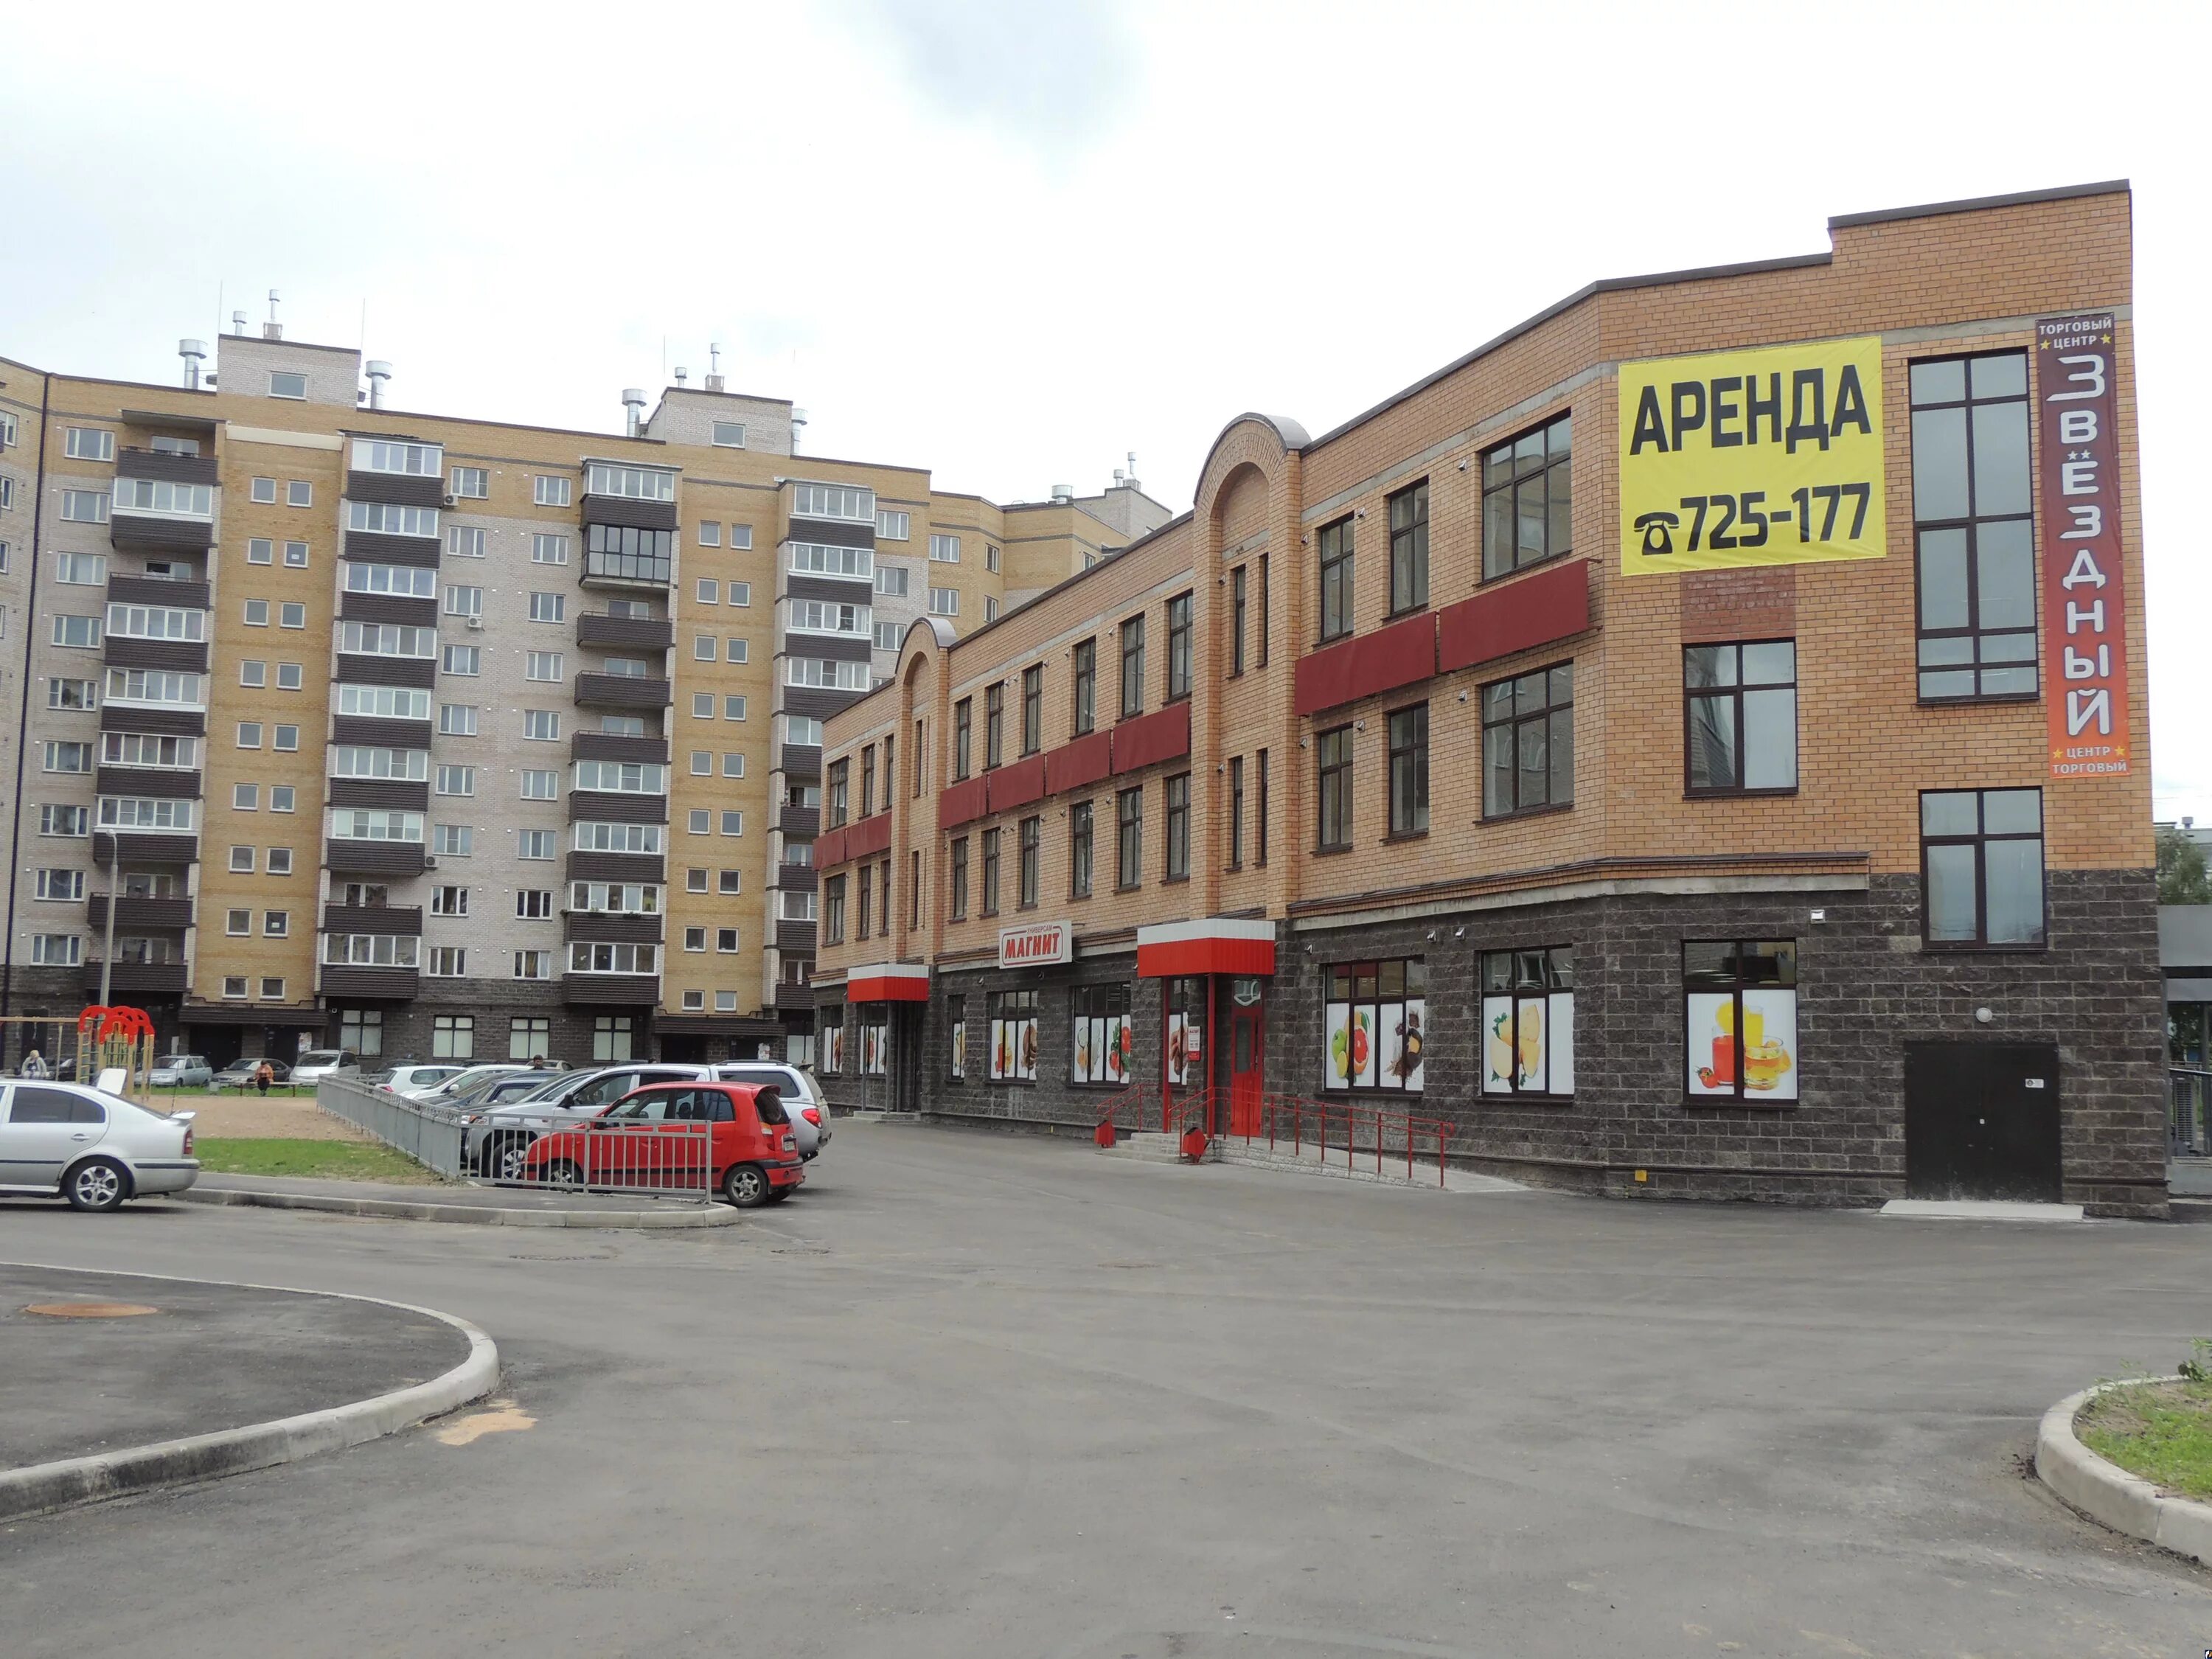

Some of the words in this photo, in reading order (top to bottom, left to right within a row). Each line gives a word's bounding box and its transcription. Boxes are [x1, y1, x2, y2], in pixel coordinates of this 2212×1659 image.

[2039, 316, 2112, 335] ТОРГОВЫЙ
[2053, 335, 2097, 349] ЦЕНТР
[1630, 364, 1871, 456] АРЕНДА
[1680, 482, 1871, 552] 725-177
[2046, 354, 2110, 736] ЗВЁЗДНЫЙ
[2066, 746, 2111, 759] ЦЕНТР
[2053, 759, 2126, 774] ТОРГОВЫЙ
[1005, 933, 1060, 959] МАГНИТ
